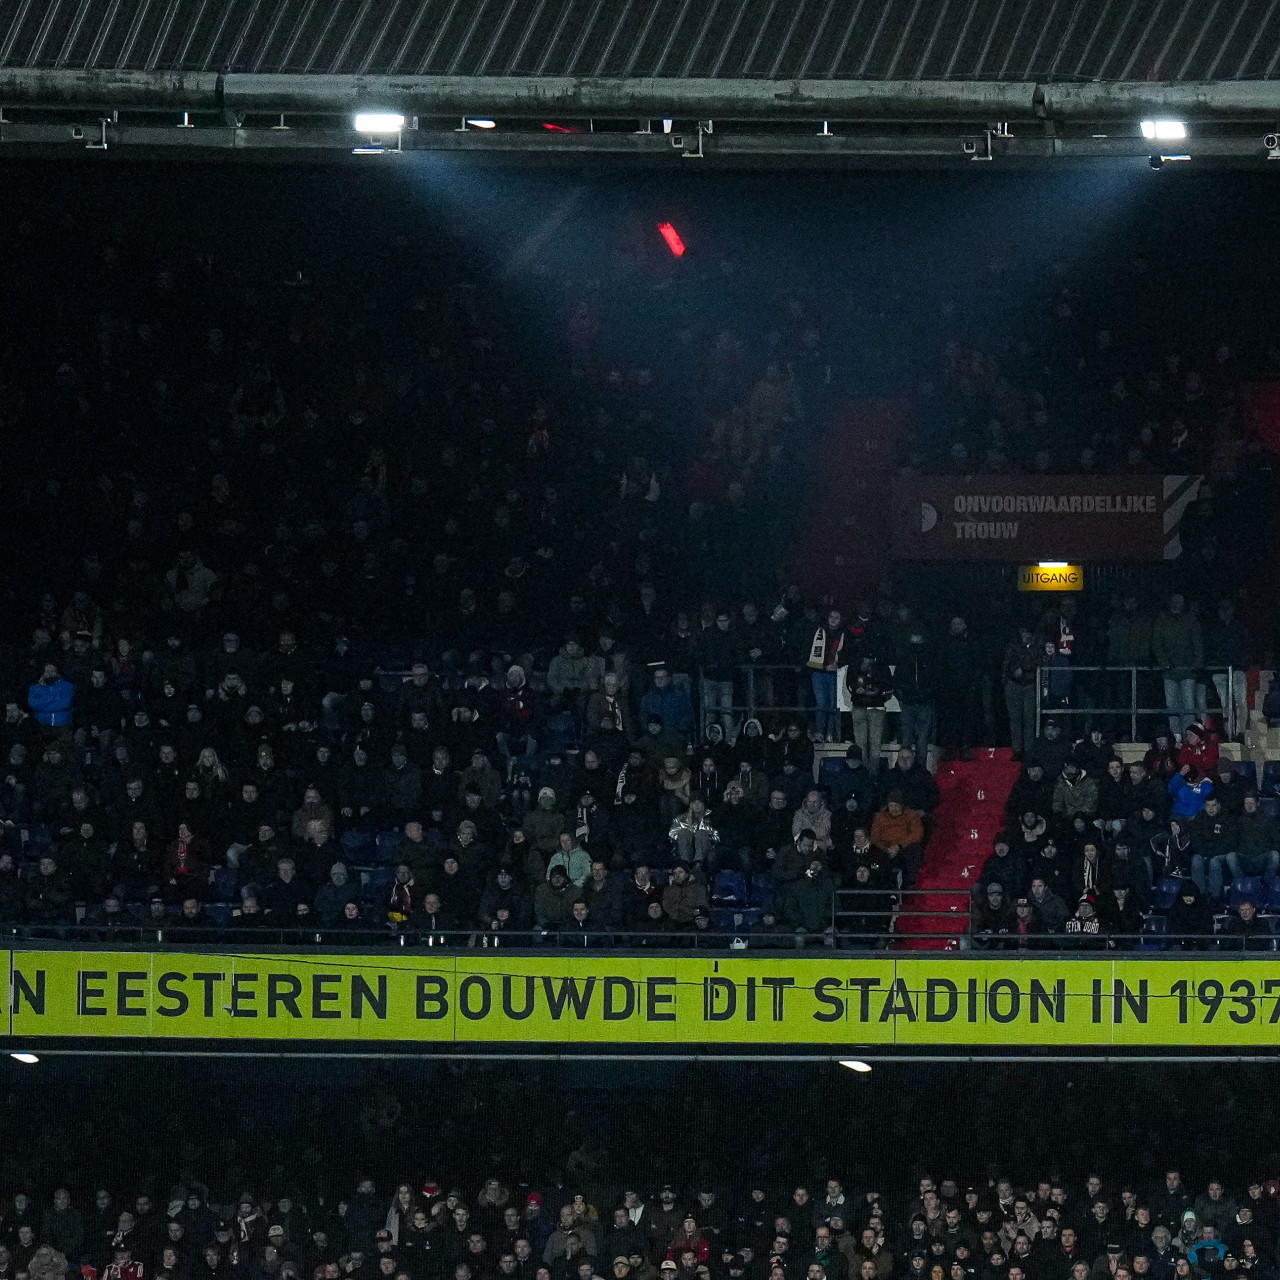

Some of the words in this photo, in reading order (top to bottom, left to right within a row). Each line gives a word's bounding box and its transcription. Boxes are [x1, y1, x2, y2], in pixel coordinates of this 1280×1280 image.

[954, 495, 1157, 514] ONVOORWAARDELIJKE
[954, 521, 1019, 539] TROUW
[1023, 572, 1079, 584] UITGANG
[12, 970, 47, 1016] N
[76, 971, 389, 1020] EESTEREN
[415, 975, 677, 1023] BOUWDE
[705, 977, 785, 1023] DIT
[813, 977, 1066, 1024] STADION
[1092, 979, 1148, 1024] IN
